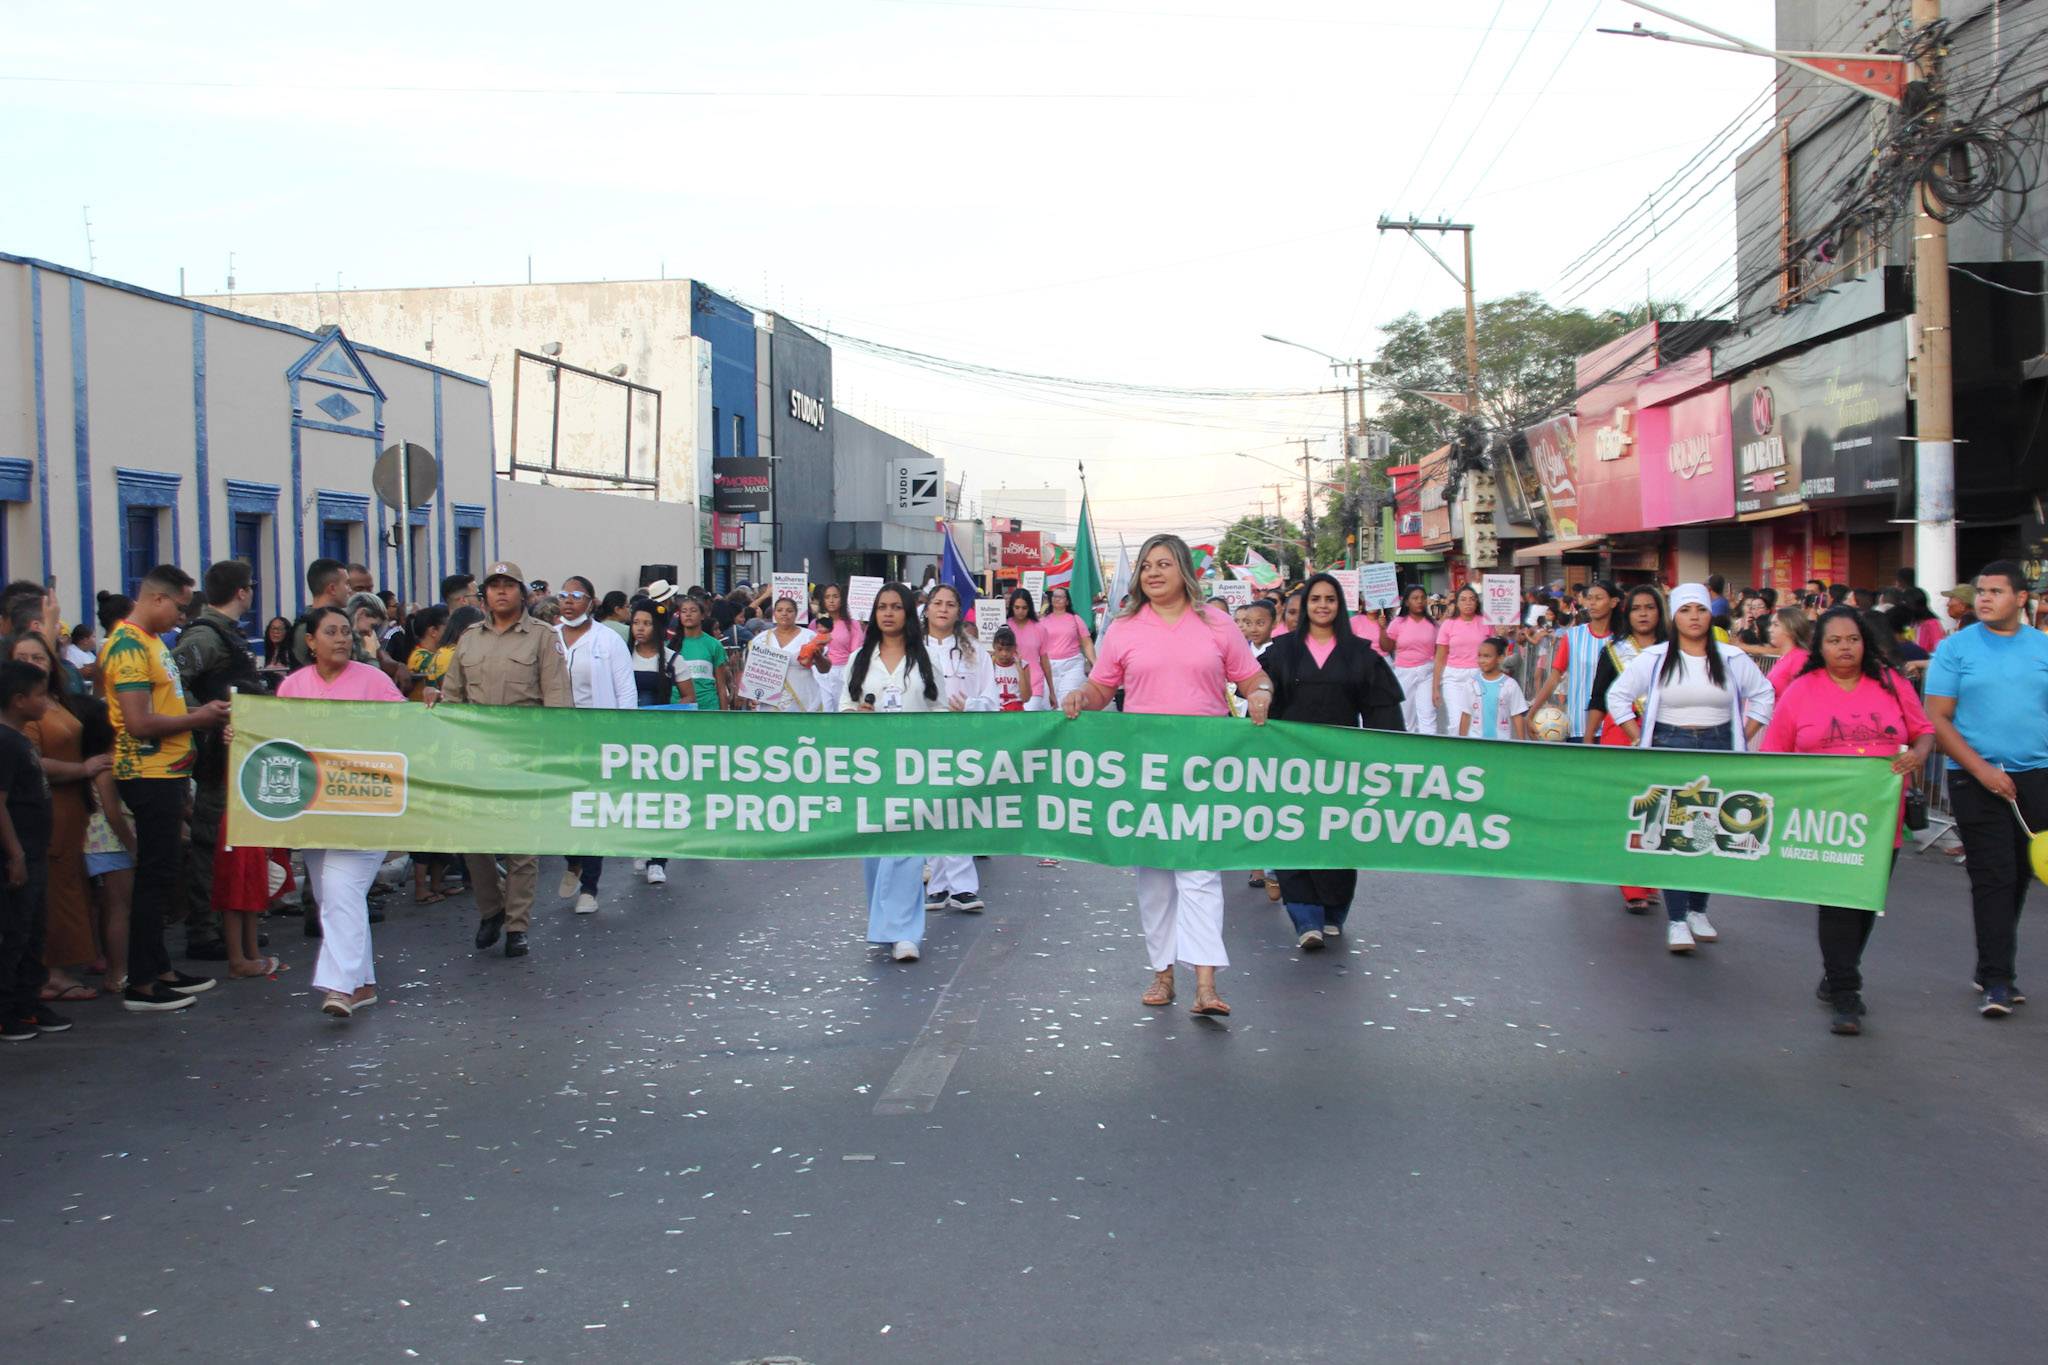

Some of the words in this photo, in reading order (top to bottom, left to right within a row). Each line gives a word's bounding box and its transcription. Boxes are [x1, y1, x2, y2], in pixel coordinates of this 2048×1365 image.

[790, 389, 818, 427] STUDIO
[744, 486, 769, 494] MAKES
[779, 590, 803, 601] 20%
[1490, 588, 1514, 598] 10%
[752, 645, 788, 661] Mulheres
[748, 665, 783, 681] TRABALHO
[327, 767, 393, 785] VÁRZEA
[601, 735, 881, 785] PROFISSÕES
[897, 750, 1126, 792] DESAFIOS
[1141, 753, 1169, 791] E
[1183, 756, 1485, 802] CONQUISTAS
[325, 784, 393, 798] GRANDE
[570, 791, 691, 830] EMEB
[706, 794, 841, 832] PROFª
[857, 796, 1022, 833] LENINE
[1037, 795, 1093, 835] DE
[1107, 800, 1304, 841] CAMPOS
[1319, 799, 1511, 850] PÓVOAS
[1782, 808, 1868, 848] ANOS
[1780, 846, 1817, 861] VÁRZEA
[1822, 850, 1864, 866] GRANDE
